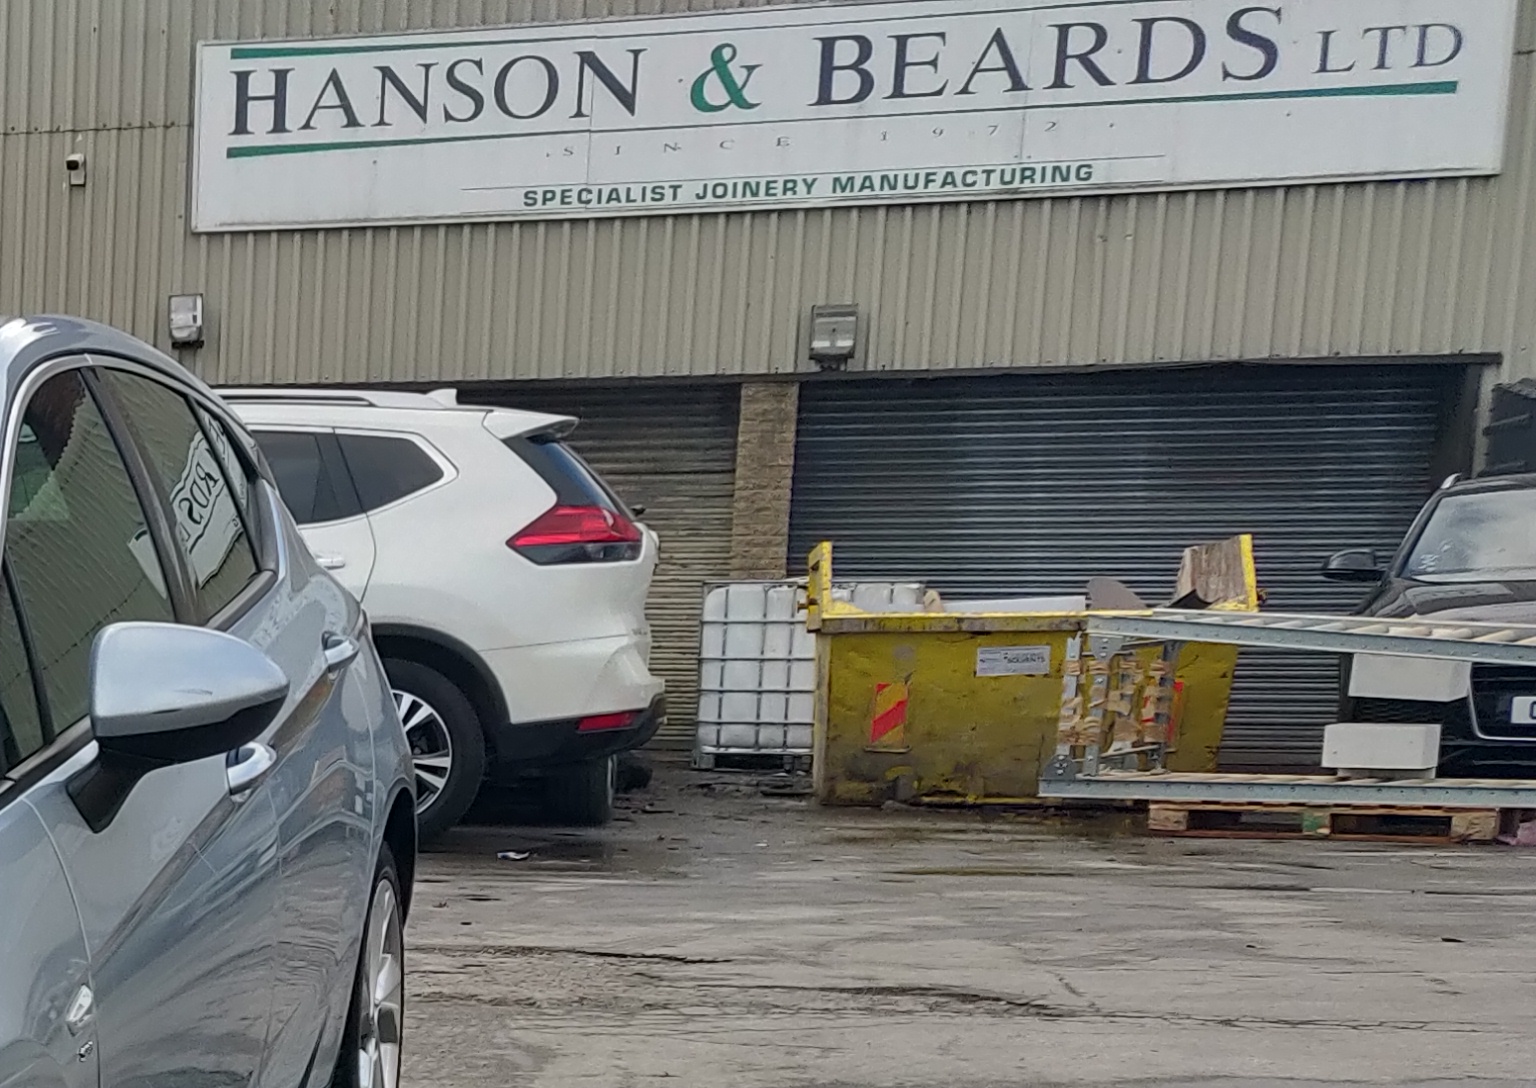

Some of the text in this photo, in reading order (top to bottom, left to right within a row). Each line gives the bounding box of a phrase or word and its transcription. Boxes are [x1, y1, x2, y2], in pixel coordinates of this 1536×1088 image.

[227, 5, 1464, 136] HANSON & BEARDS LTD
[522, 163, 1094, 208] SPECIALIST JOINERY MANUFACTURING
